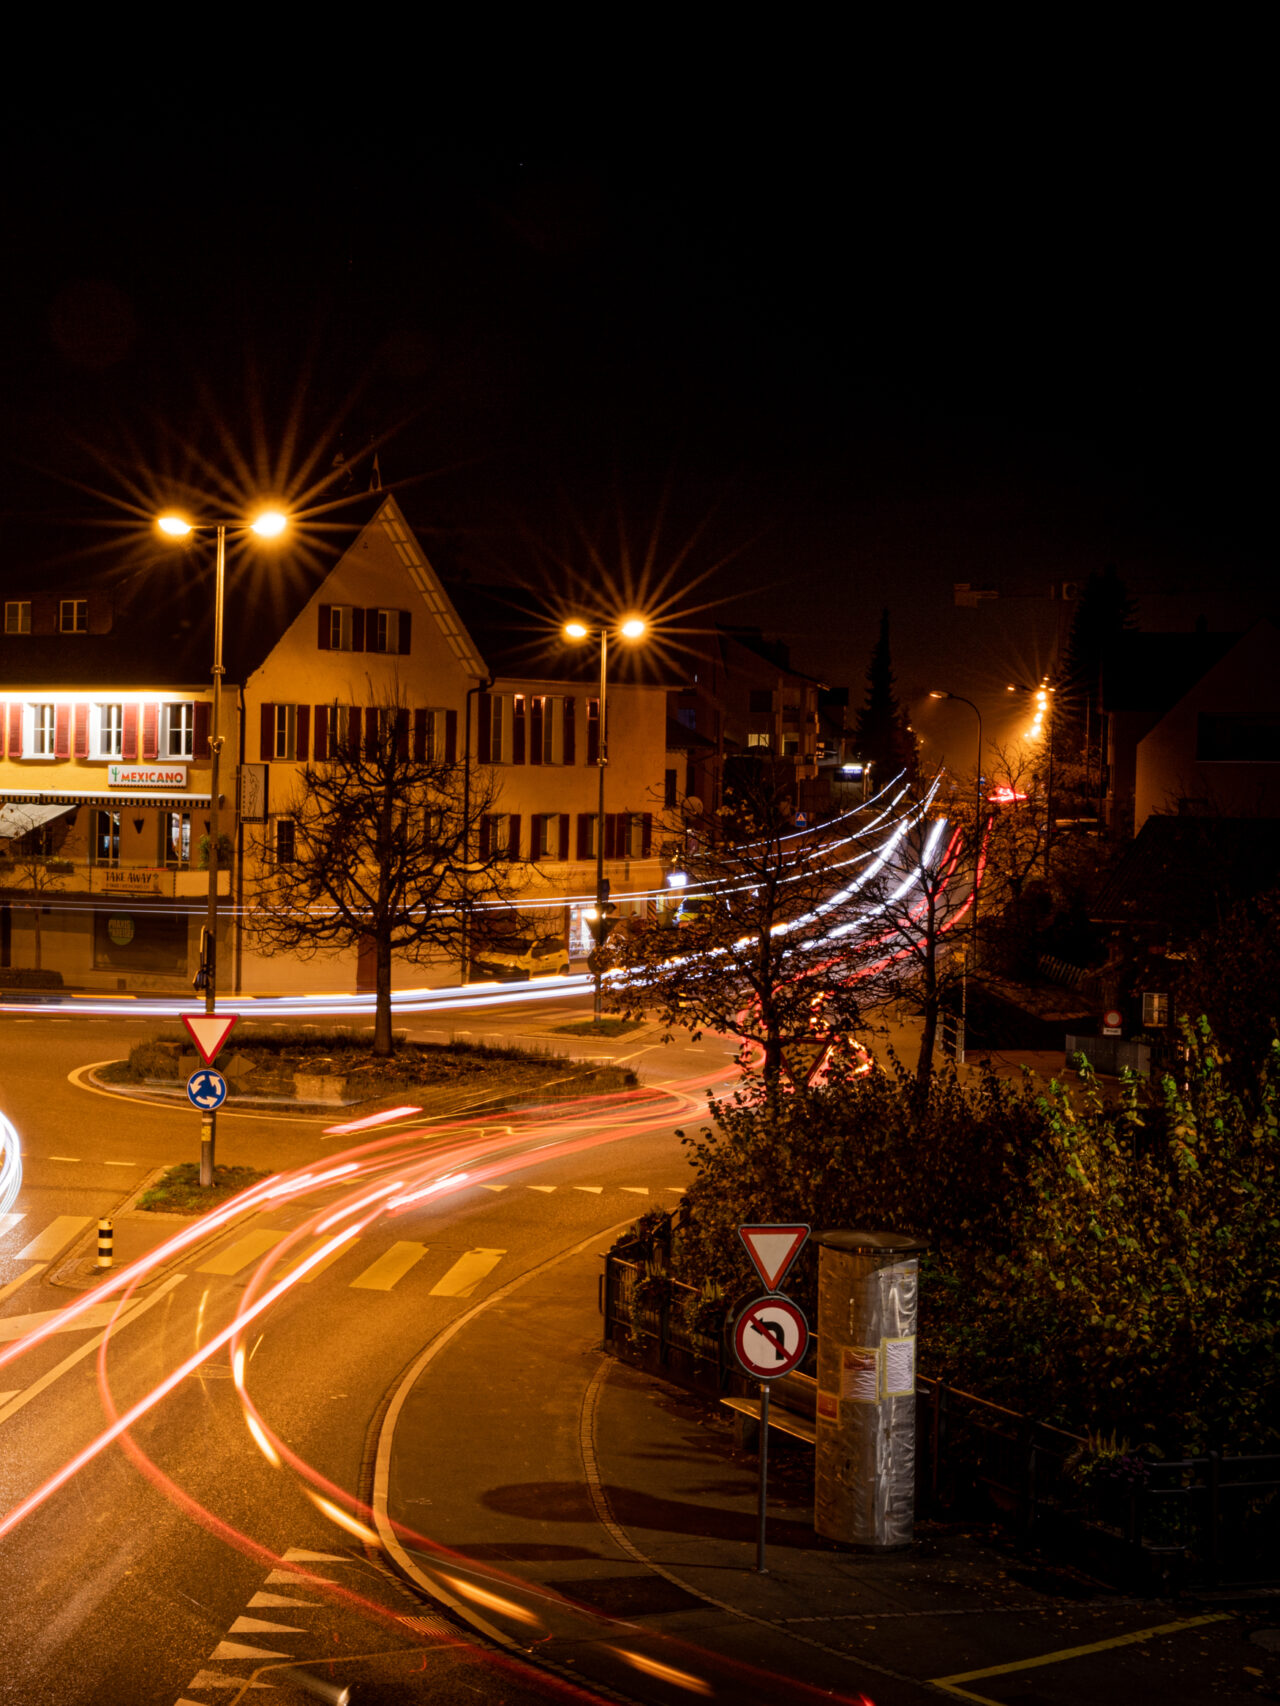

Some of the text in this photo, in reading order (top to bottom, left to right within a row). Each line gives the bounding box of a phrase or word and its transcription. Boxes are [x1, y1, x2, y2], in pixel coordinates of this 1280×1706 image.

[121, 772, 184, 783] MEXICANO
[104, 871, 152, 883] TAKE AWAY
